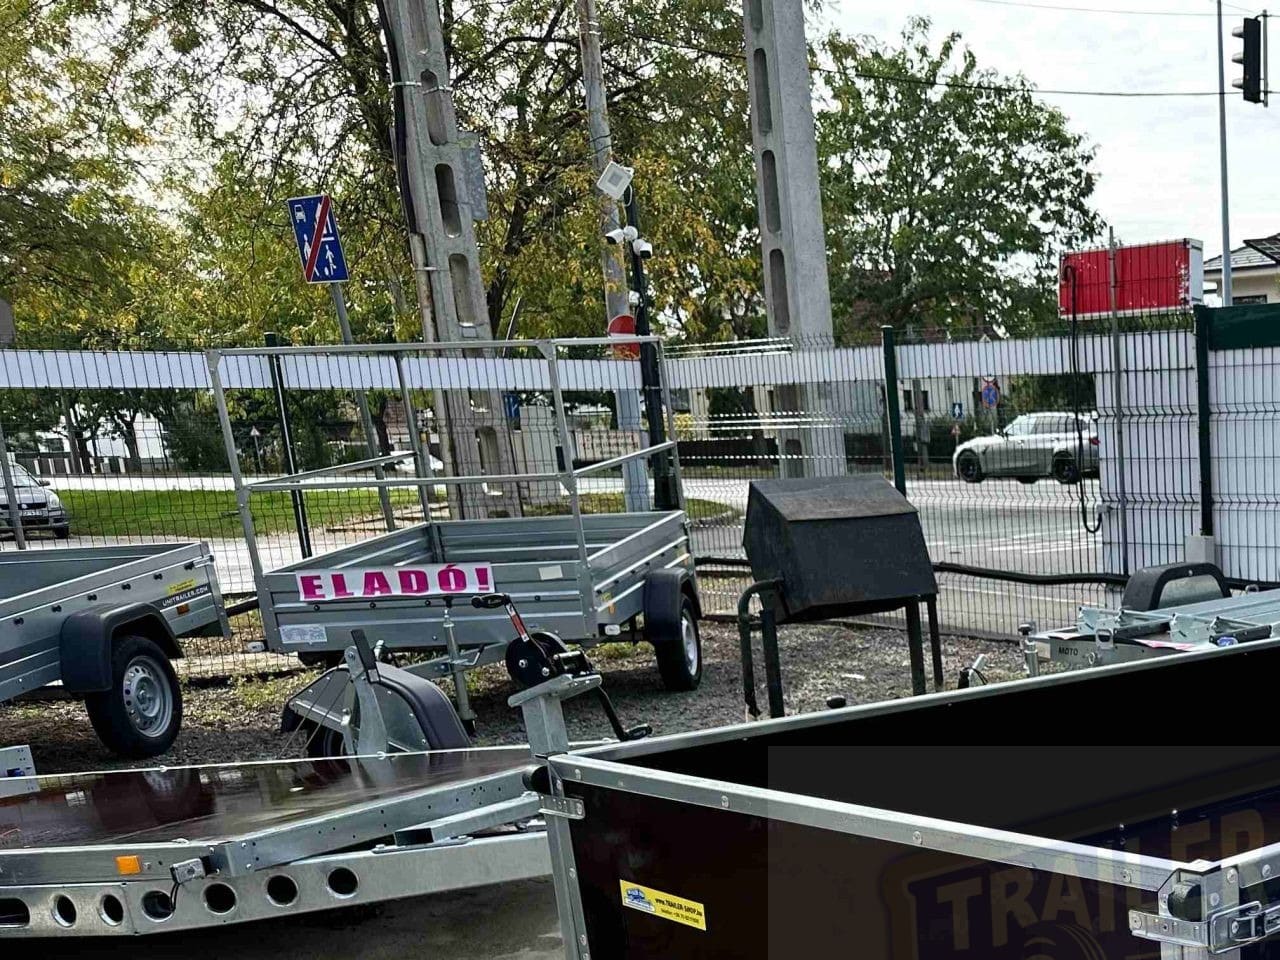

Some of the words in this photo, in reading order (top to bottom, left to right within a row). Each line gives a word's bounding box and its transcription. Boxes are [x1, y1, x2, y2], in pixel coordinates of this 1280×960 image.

[300, 564, 490, 600] ELADÓ!
[162, 585, 209, 606] UNITRAILER.COM
[1058, 646, 1079, 656] MOTO
